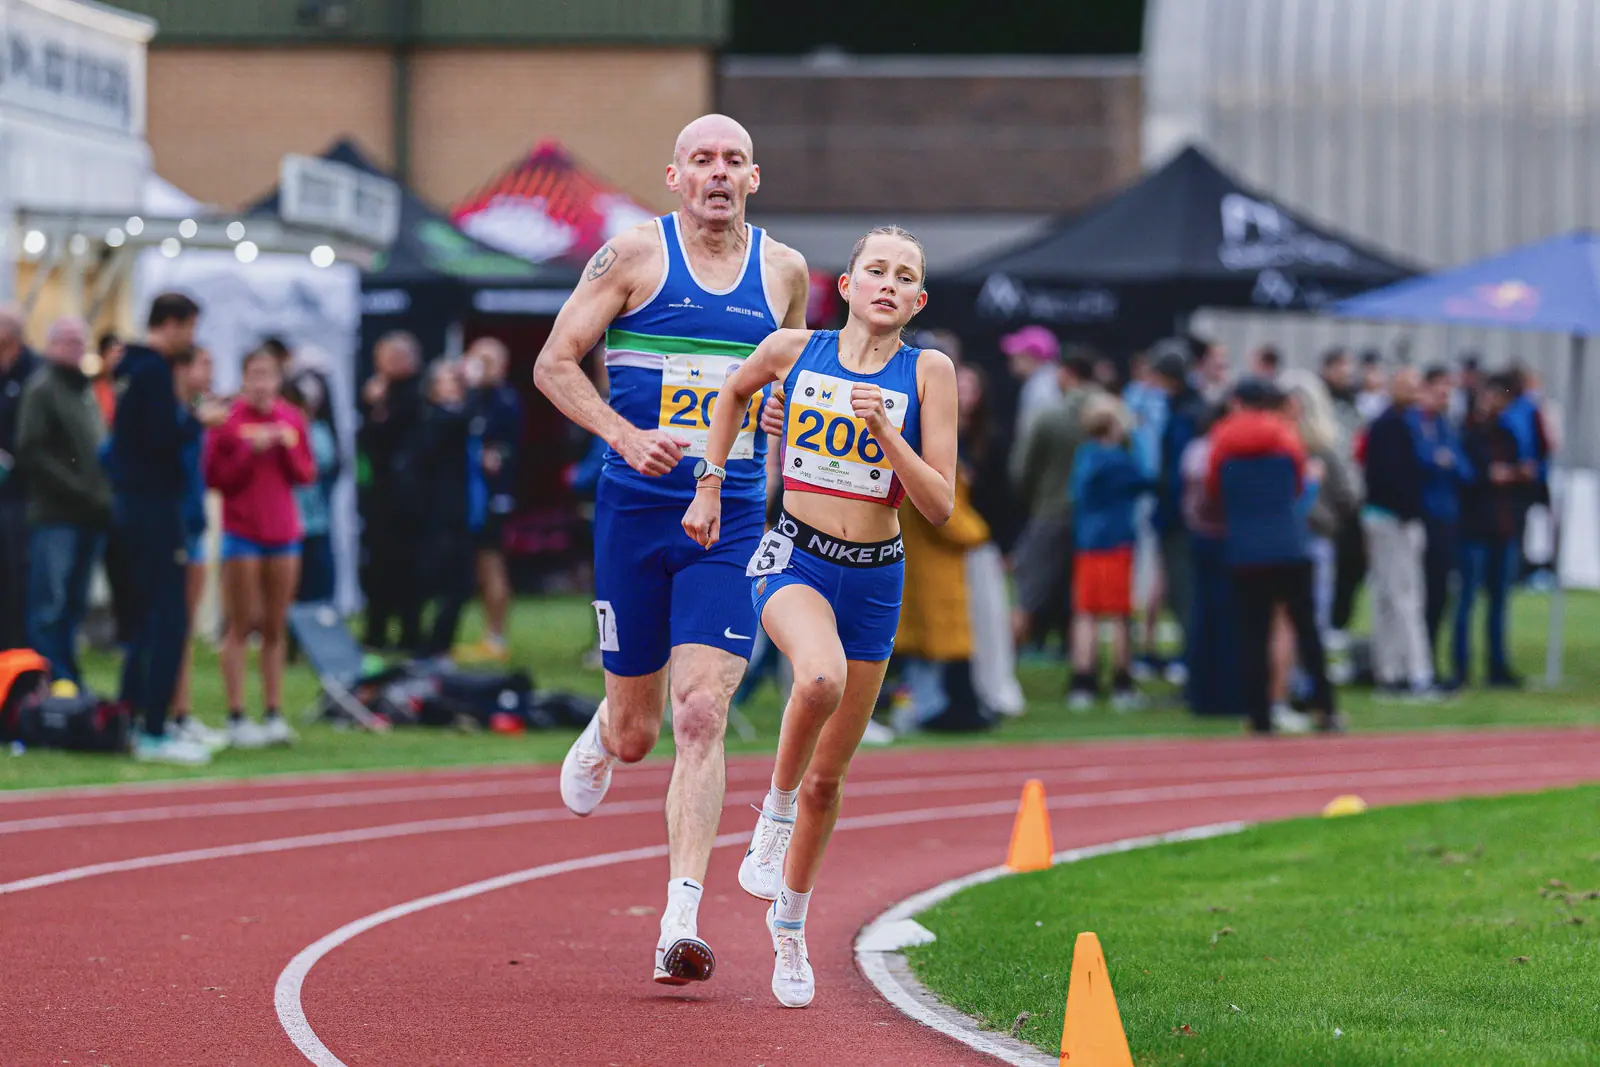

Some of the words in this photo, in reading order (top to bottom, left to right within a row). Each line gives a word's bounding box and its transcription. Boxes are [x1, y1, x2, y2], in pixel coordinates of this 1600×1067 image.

[726, 305, 751, 315] ACHILLES
[796, 409, 885, 464] 206
[756, 539, 781, 571] 5
[808, 534, 876, 563] NIKE
[878, 538, 905, 562] PR
